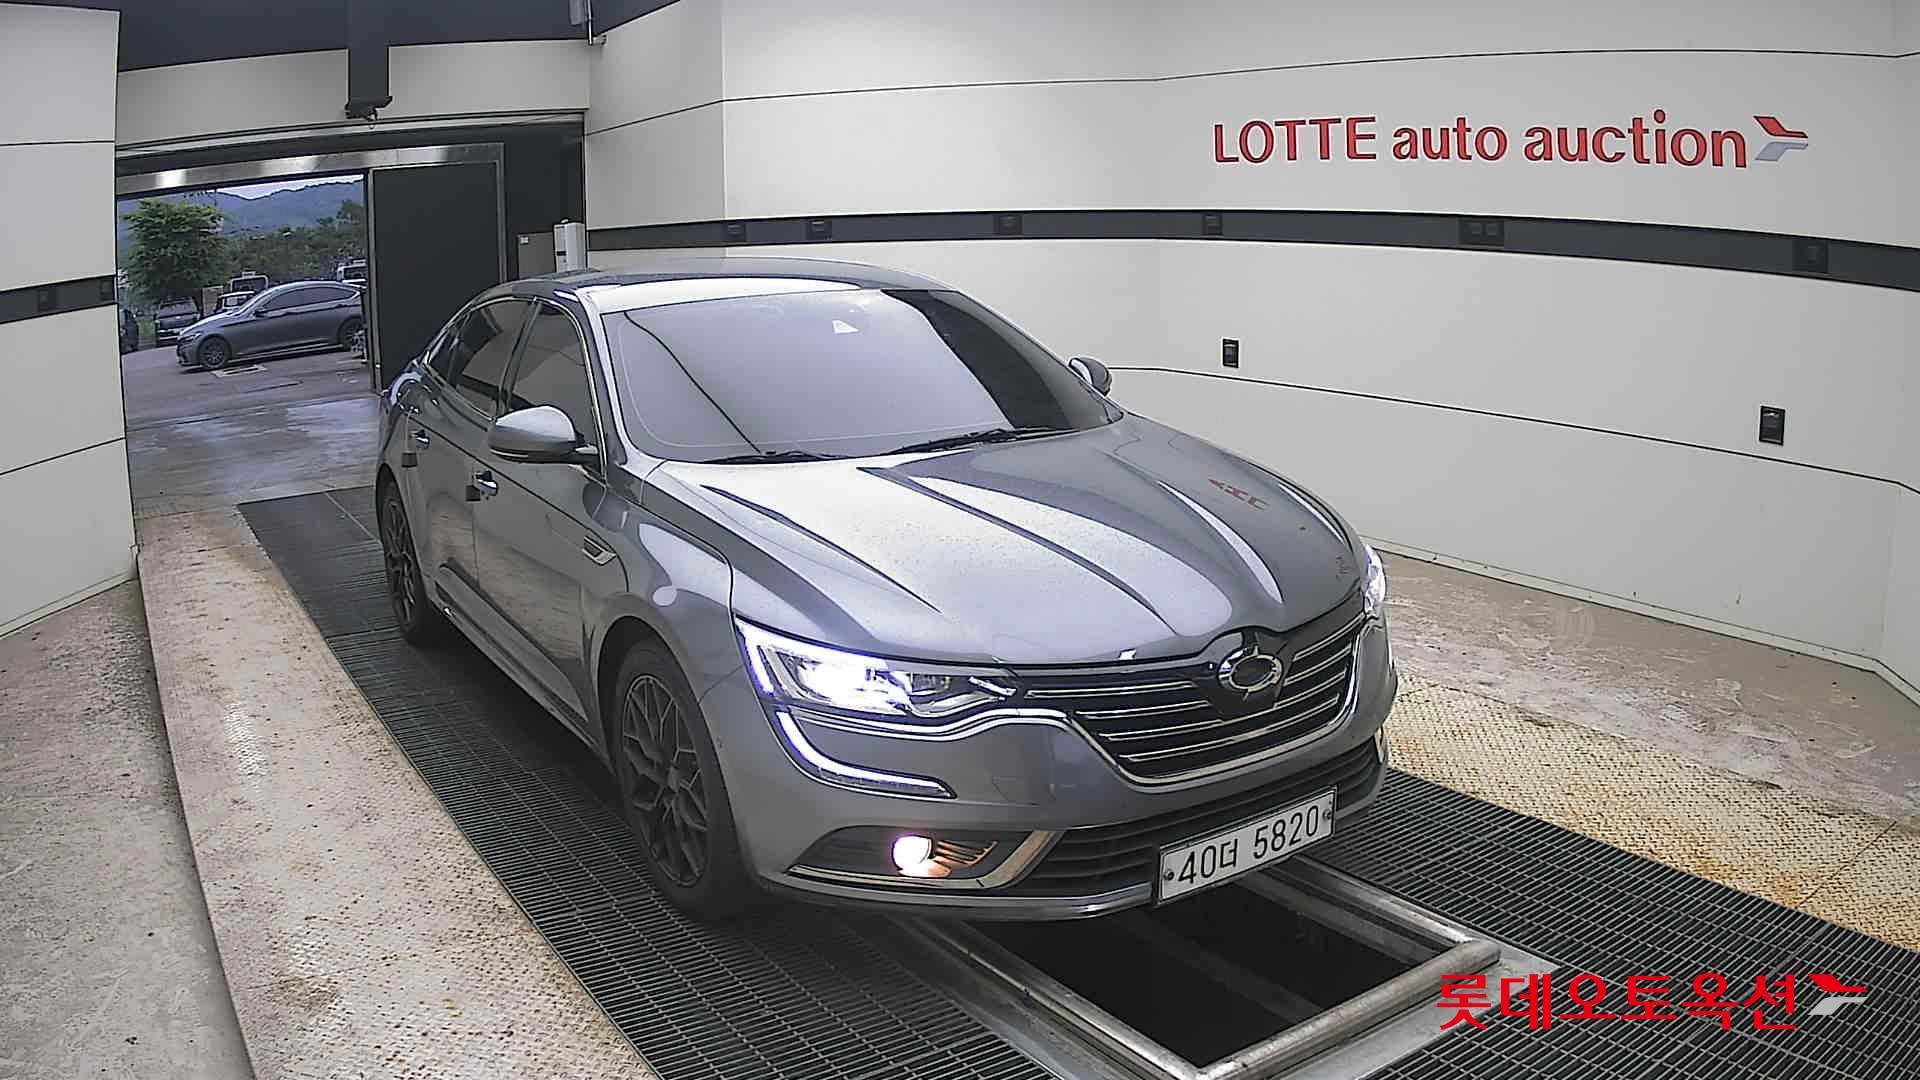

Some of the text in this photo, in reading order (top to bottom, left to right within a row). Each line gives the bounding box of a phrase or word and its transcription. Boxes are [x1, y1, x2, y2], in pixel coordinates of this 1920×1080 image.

[1214, 109, 1747, 168] LOTTE auto auction
[1178, 805, 1319, 884] 40더 5820
